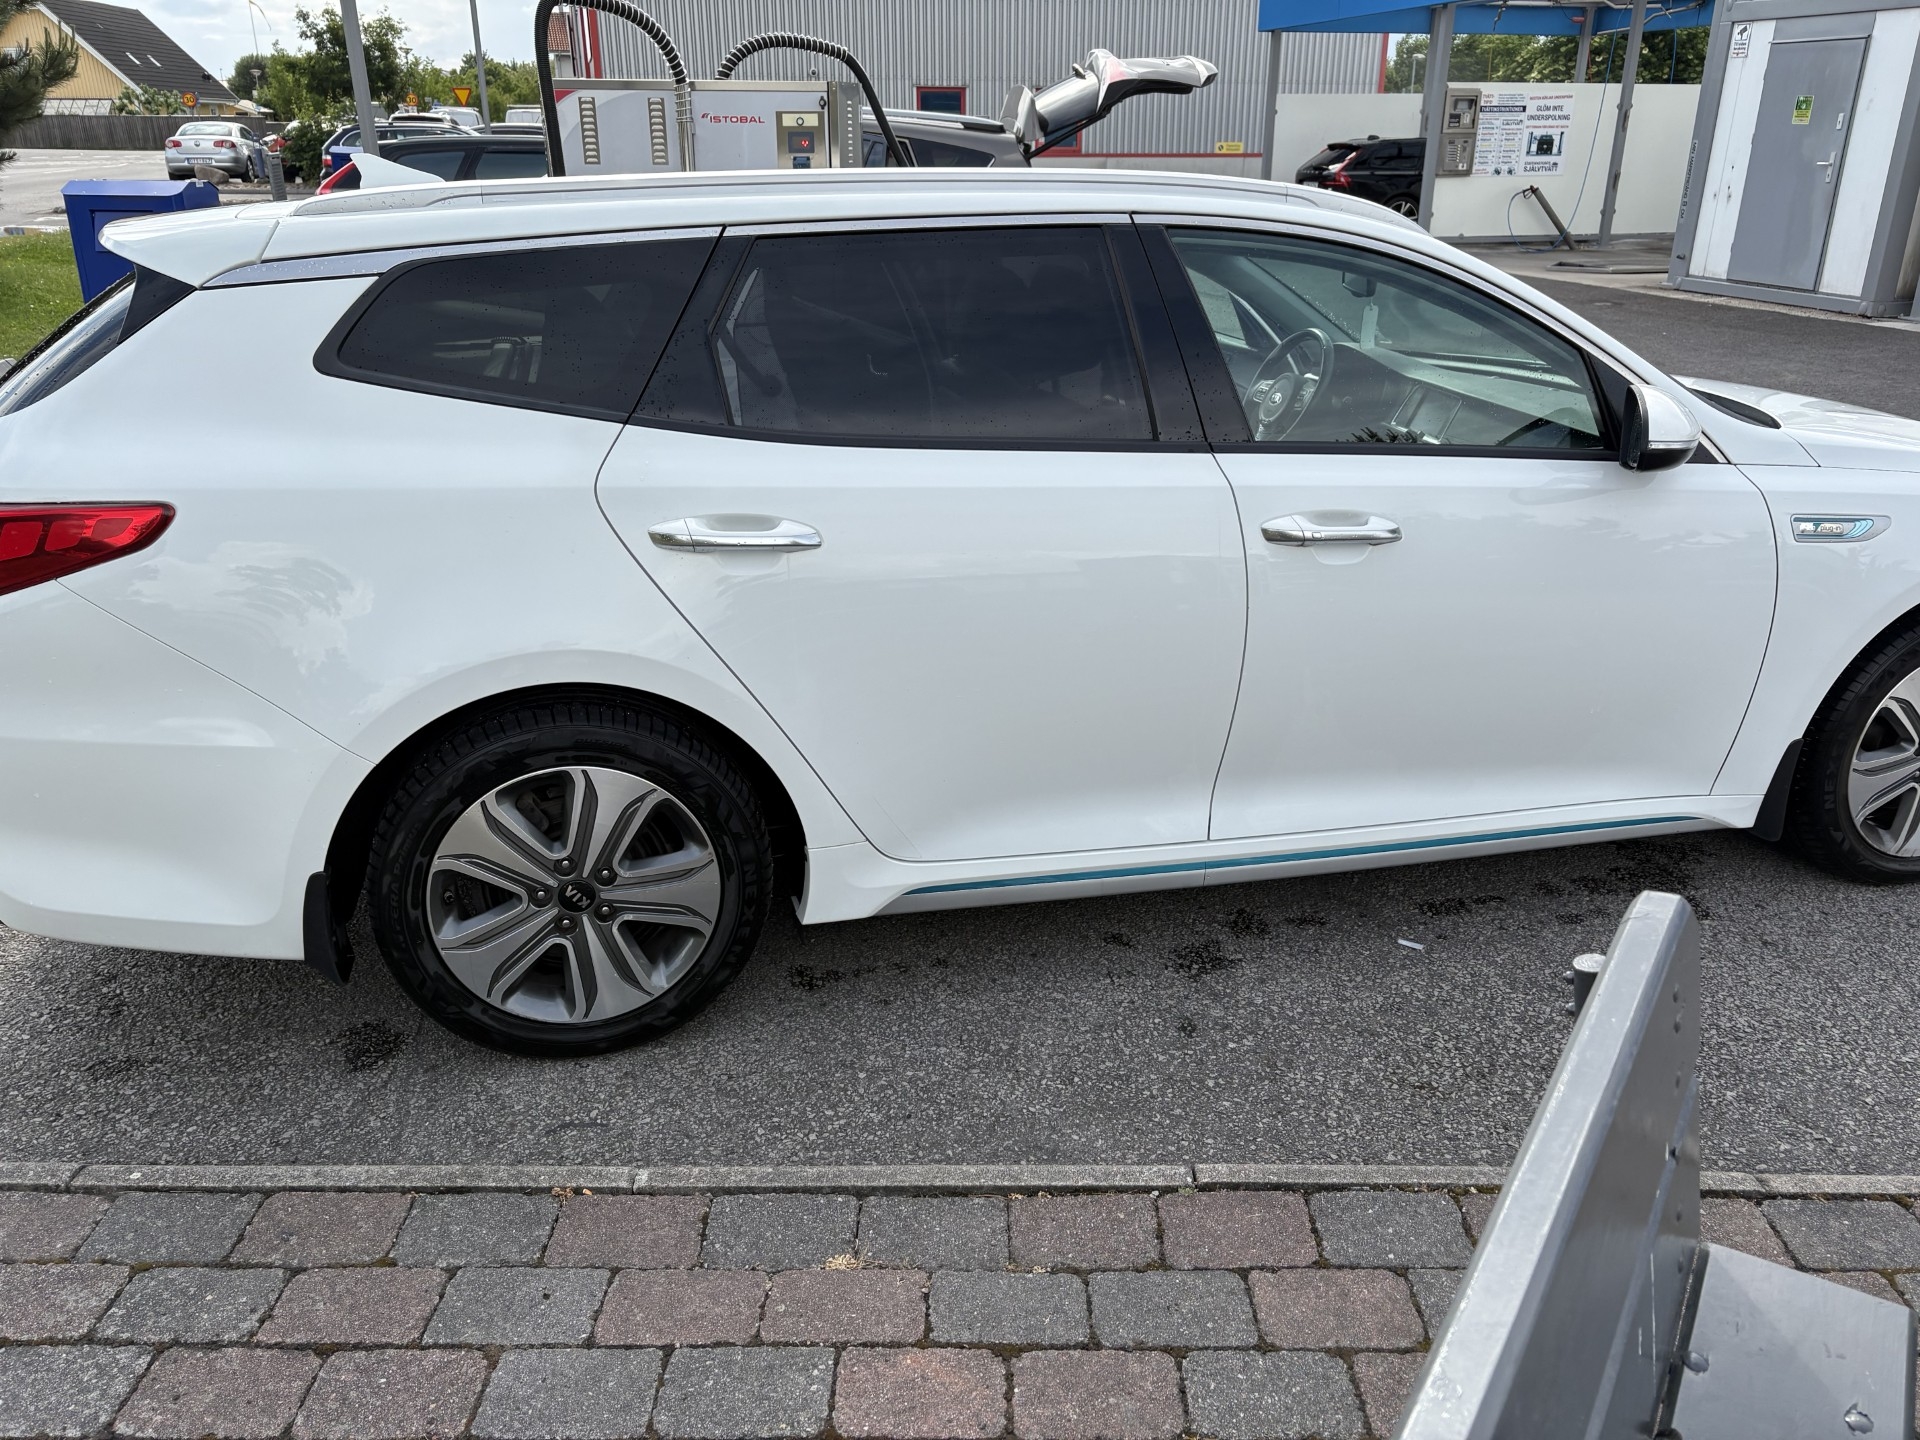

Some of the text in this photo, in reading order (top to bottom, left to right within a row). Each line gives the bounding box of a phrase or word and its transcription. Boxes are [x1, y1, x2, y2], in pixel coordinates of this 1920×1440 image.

[1536, 104, 1551, 112] GLÖM
[709, 115, 766, 124] ISTOBAL
[1523, 164, 1559, 172] SJÄLVTVÄTT
[1820, 523, 1842, 533] plug-in
[565, 885, 591, 909] KIA
[725, 863, 758, 963] NEXEN
